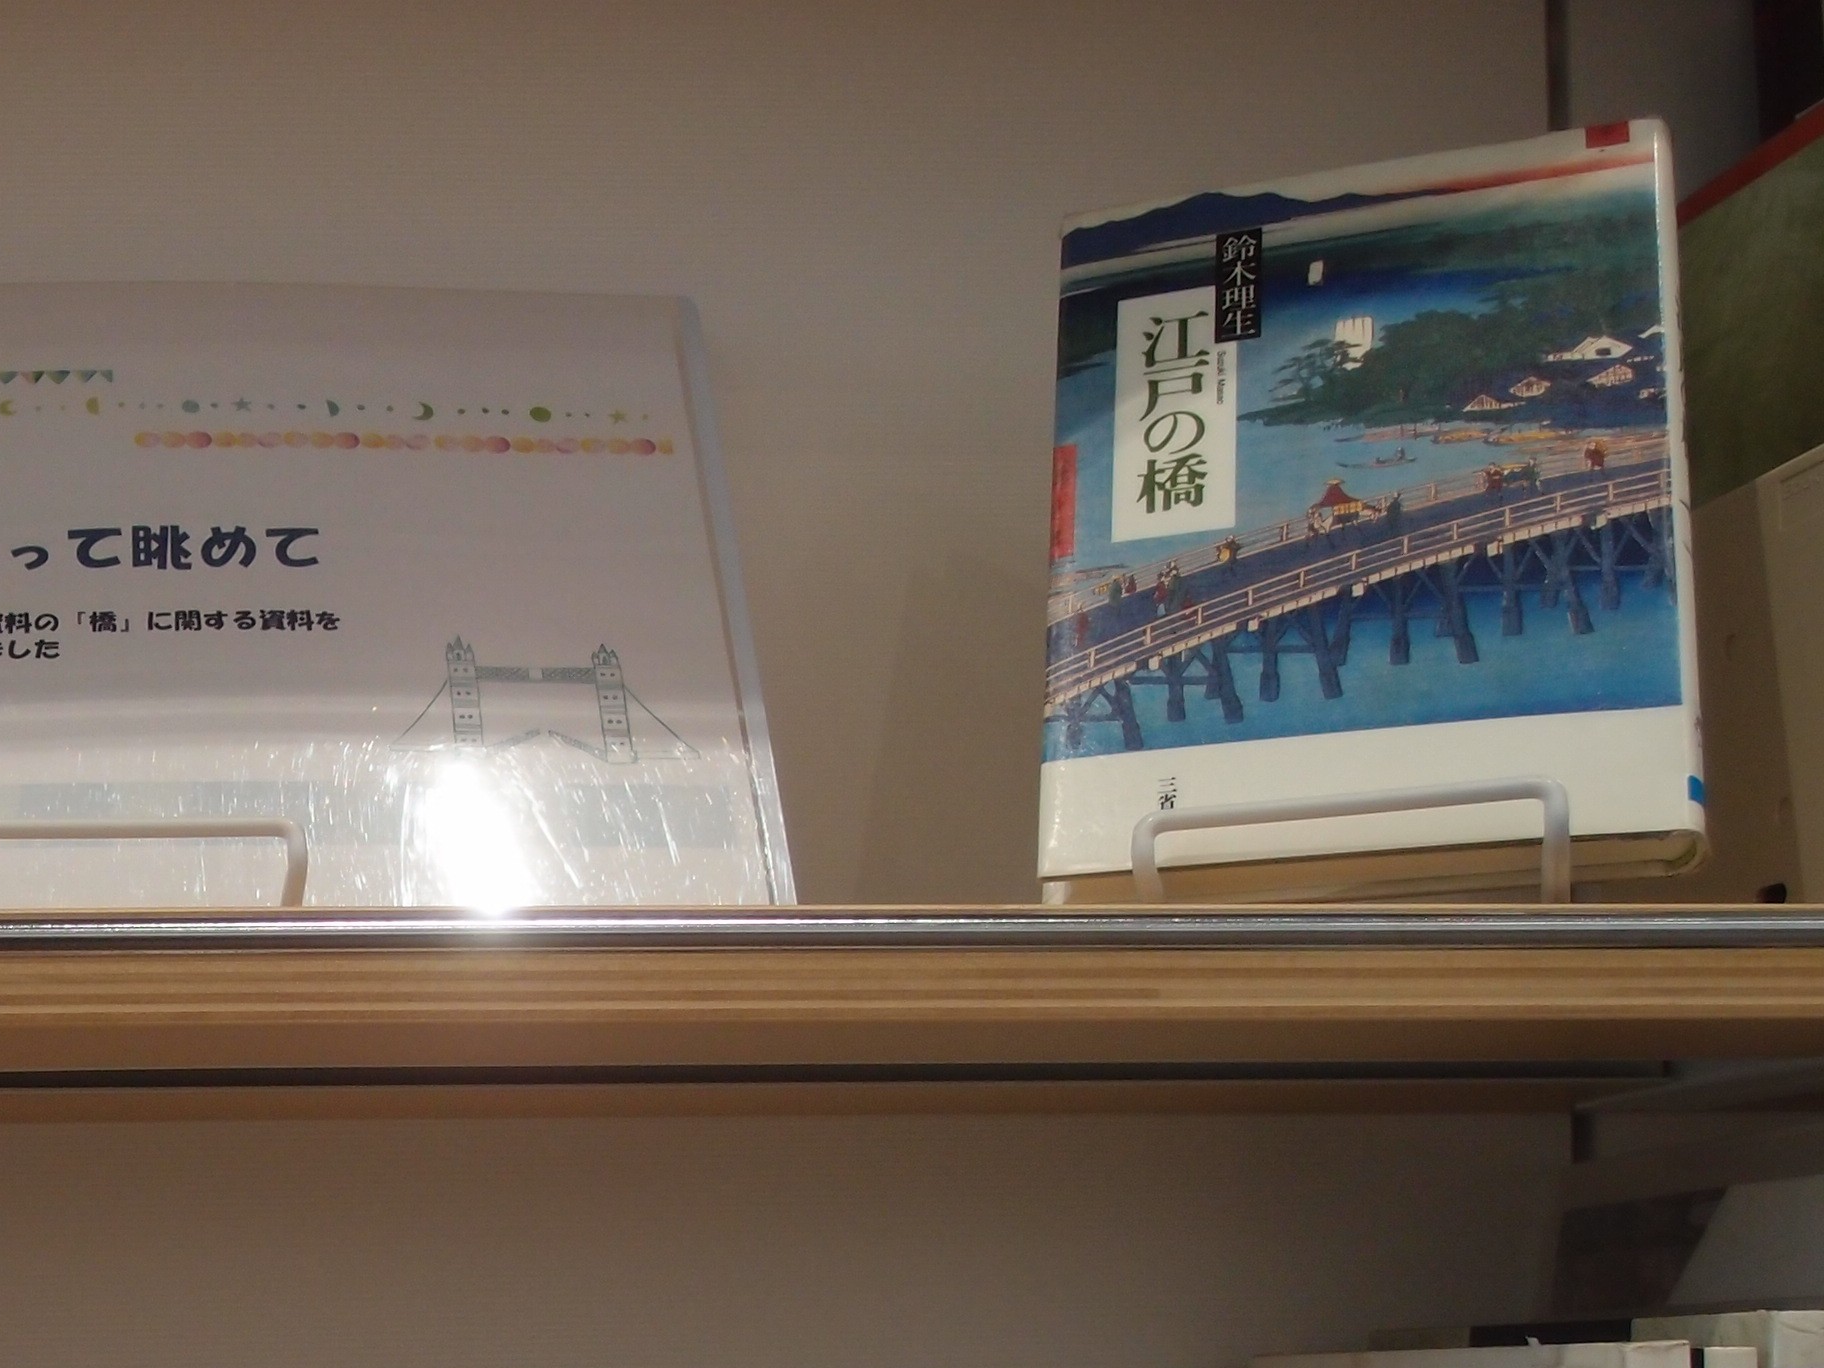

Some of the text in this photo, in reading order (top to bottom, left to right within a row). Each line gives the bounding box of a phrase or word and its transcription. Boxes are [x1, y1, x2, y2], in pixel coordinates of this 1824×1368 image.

[1221, 234, 1258, 339] 鈴木理生
[1136, 310, 1211, 515] 江戸の橋
